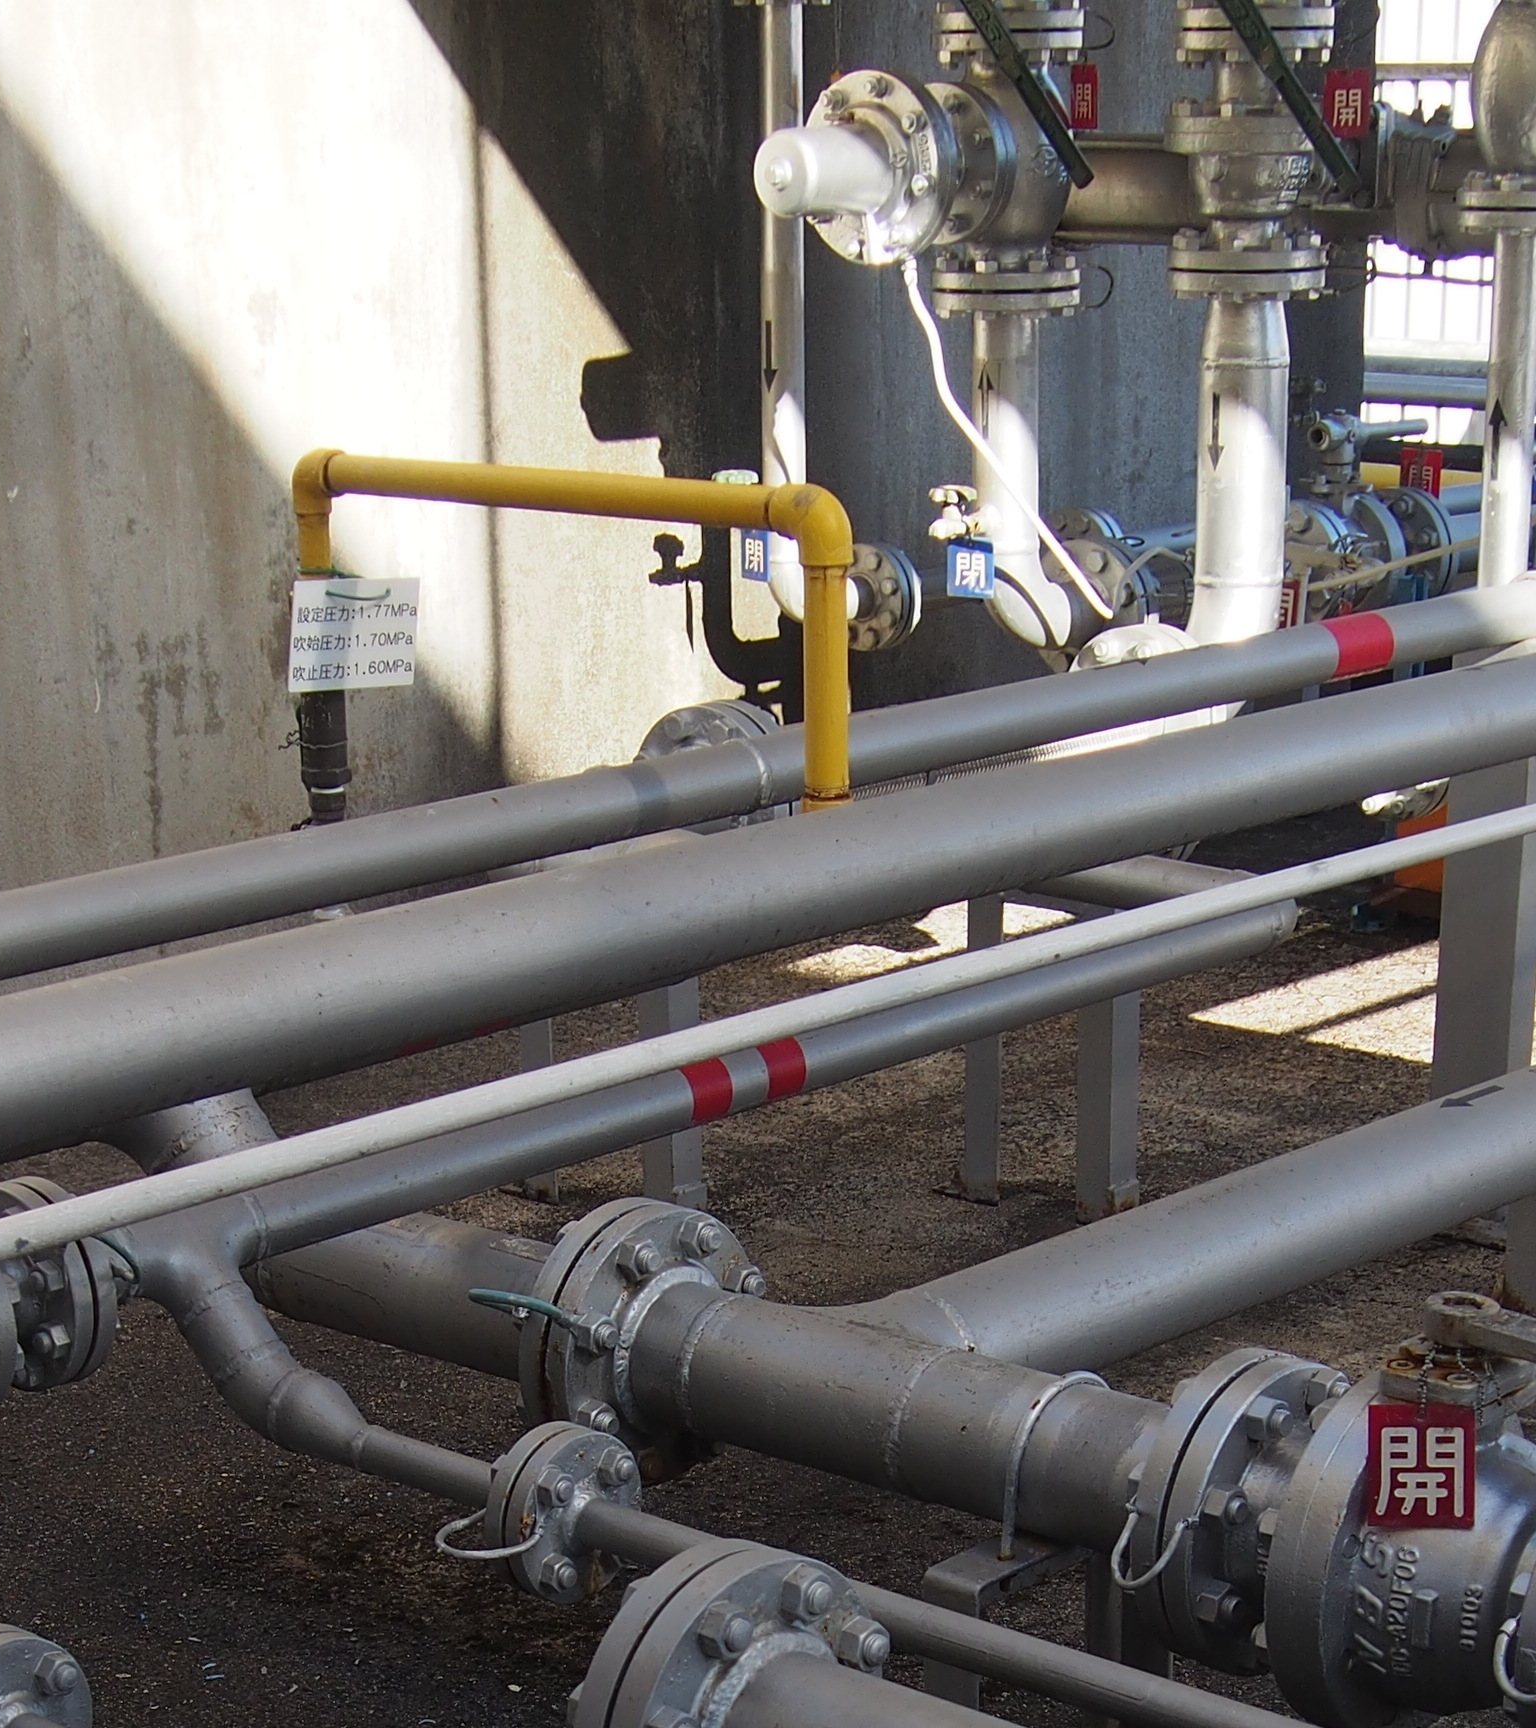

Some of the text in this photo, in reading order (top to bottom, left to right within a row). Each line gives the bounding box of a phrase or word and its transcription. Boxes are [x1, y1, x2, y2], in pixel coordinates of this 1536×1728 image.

[1075, 83, 1092, 120] 開
[1332, 88, 1362, 127] 開
[745, 537, 764, 573] 閉
[954, 551, 986, 589] 閉
[1375, 1427, 1465, 1518] 開
